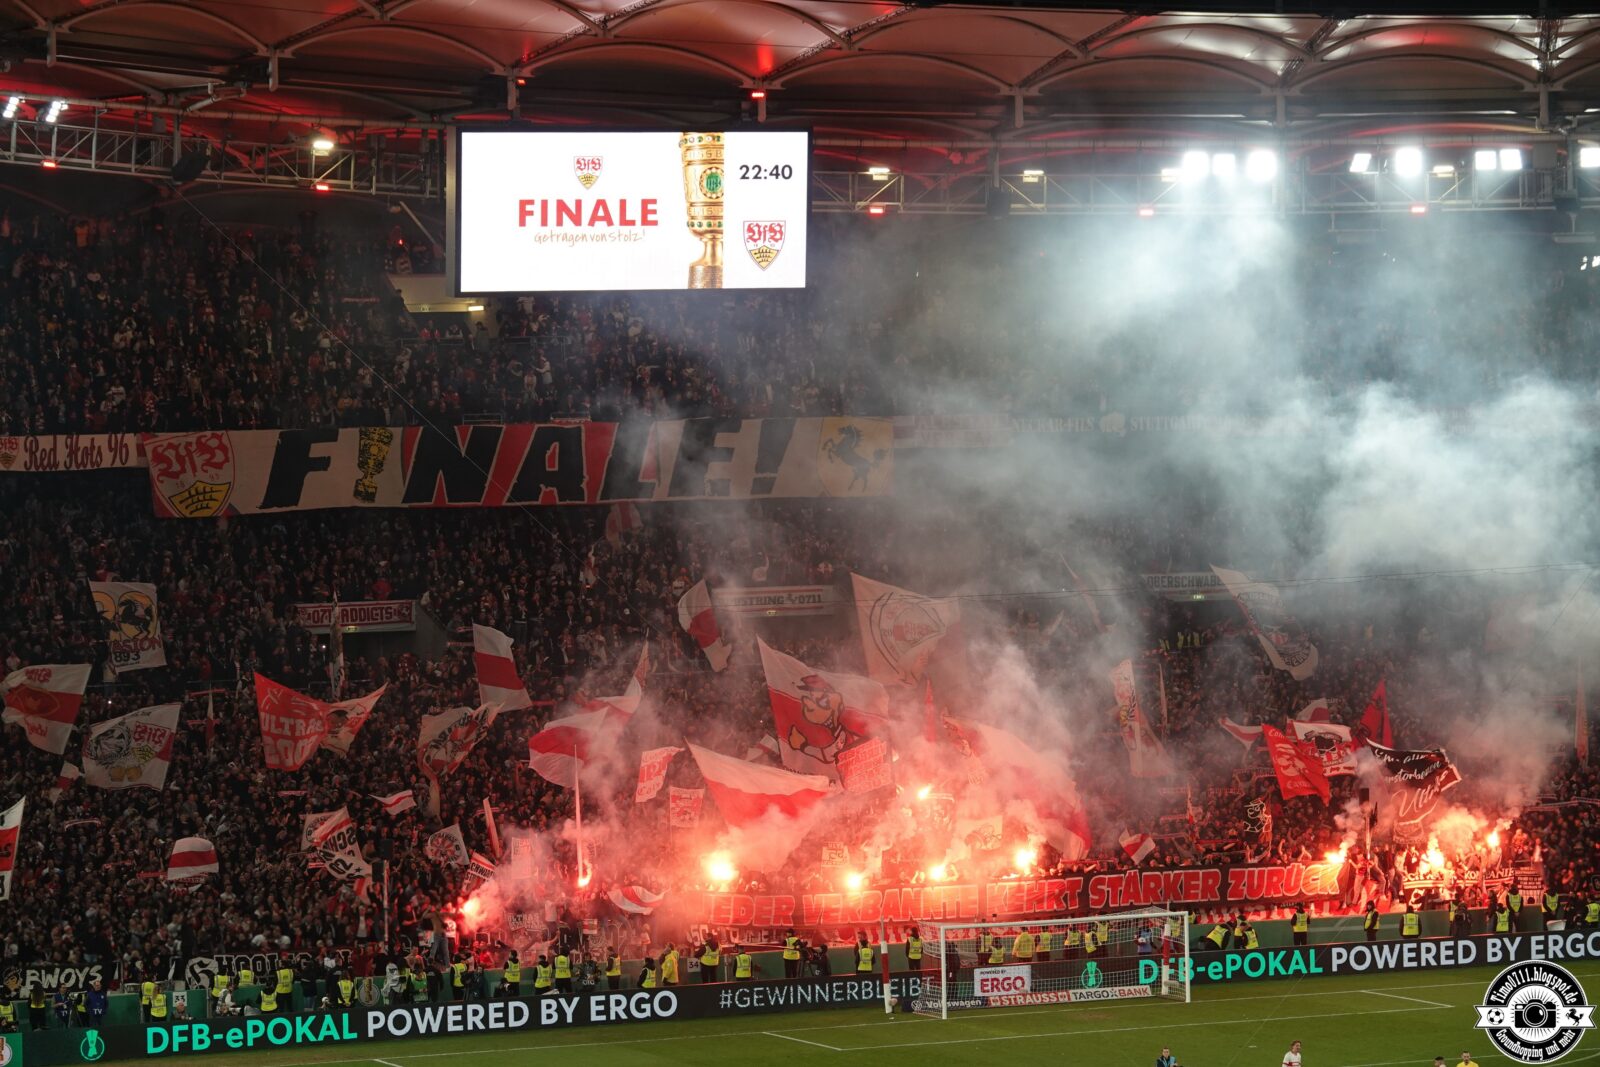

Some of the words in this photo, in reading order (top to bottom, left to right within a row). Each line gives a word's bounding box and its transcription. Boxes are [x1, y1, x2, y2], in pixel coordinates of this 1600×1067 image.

[739, 164, 793, 180] 22:40
[518, 198, 658, 227] FINALE
[24, 435, 59, 470] Red
[64, 432, 102, 470] Hots
[107, 430, 130, 467] 96
[1147, 575, 1225, 588] OBERSCHWABE
[312, 609, 333, 624] 071
[114, 651, 140, 662] 893
[703, 893, 797, 927] EDER
[1089, 868, 1221, 908] STÄRKER
[1228, 862, 1341, 900] ZURÜCK
[1331, 939, 1477, 973] POWERED
[1486, 936, 1523, 962] BY
[1530, 930, 1600, 959] ERGO
[980, 976, 1025, 993] ERGO
[926, 998, 982, 1010] Volswagen
[1001, 992, 1057, 1006] STRAUSS
[147, 1012, 358, 1054] DFB-ePOKAL
[367, 998, 530, 1038] POWERED
[540, 995, 581, 1026] BY
[590, 990, 678, 1022] ERGO
